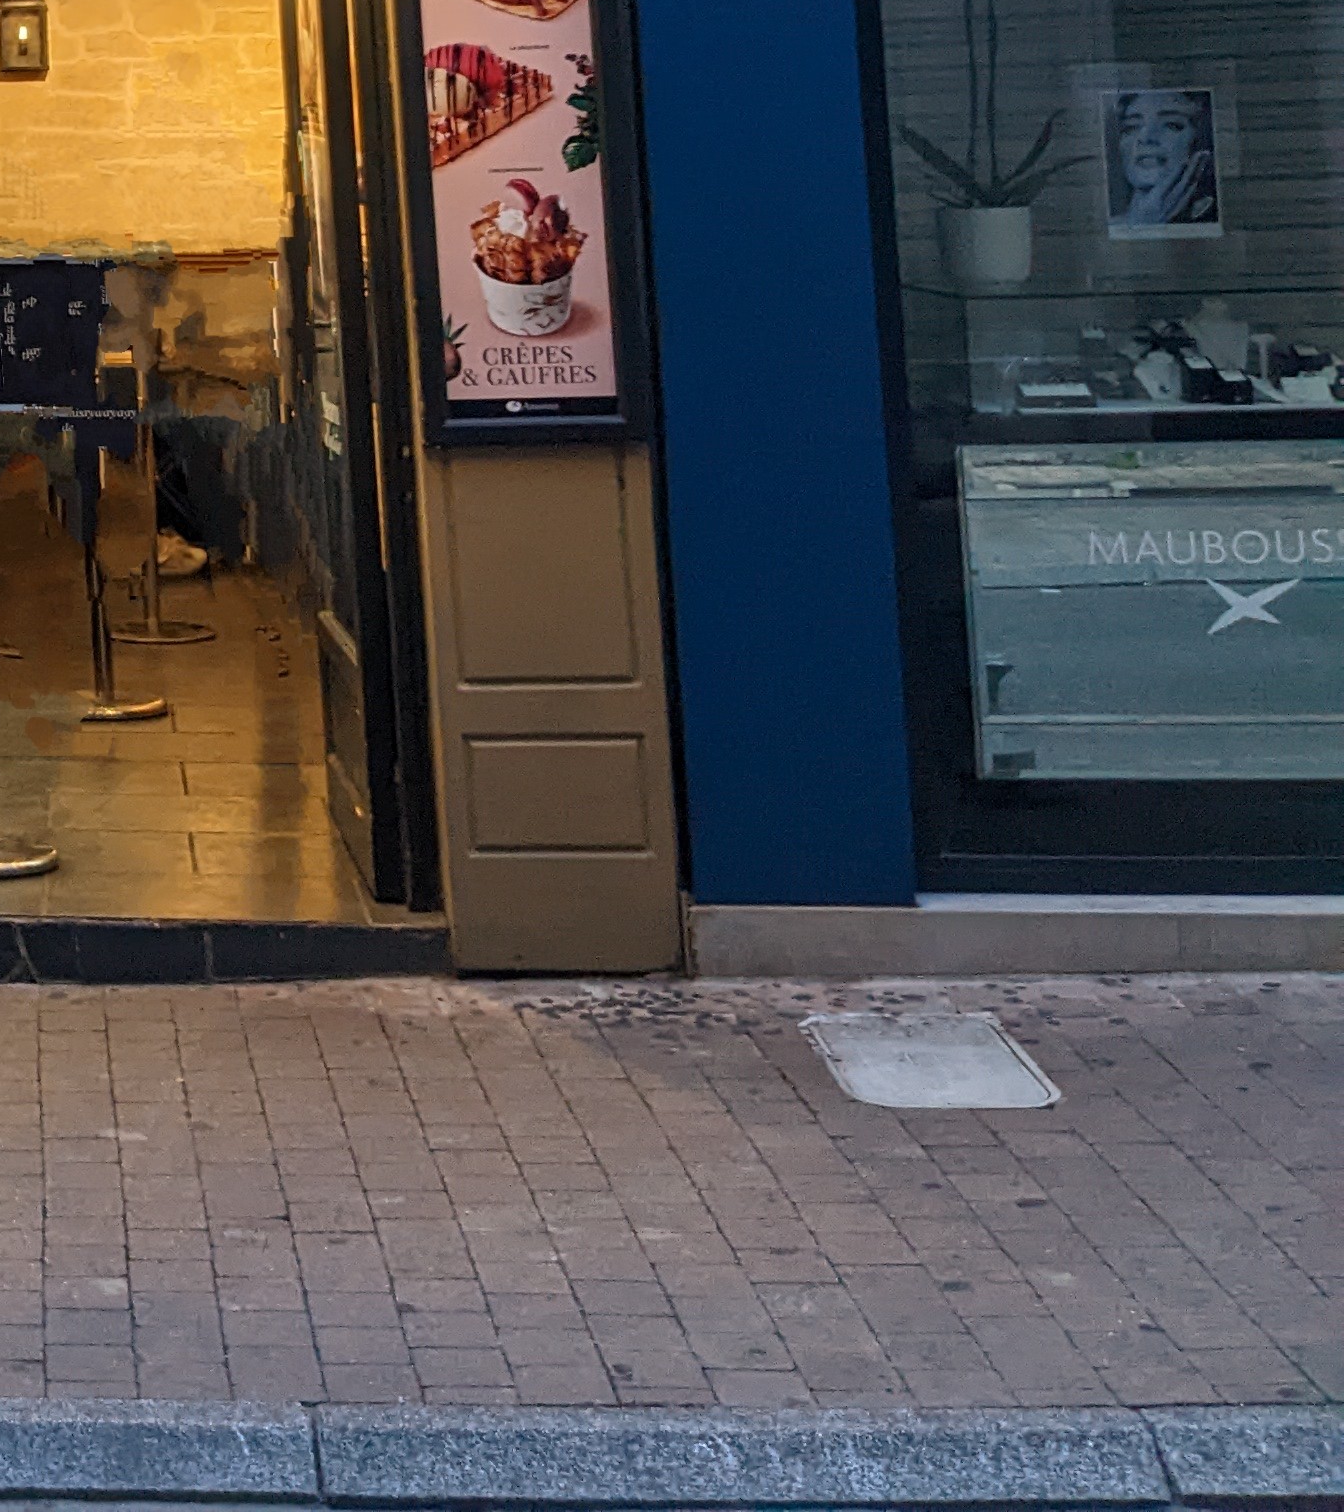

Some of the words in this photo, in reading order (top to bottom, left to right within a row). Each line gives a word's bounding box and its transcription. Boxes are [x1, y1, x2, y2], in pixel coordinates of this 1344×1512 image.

[482, 341, 574, 367] CRÊPES
[461, 367, 479, 387] &
[486, 364, 598, 387] GAUFRES
[1088, 527, 1344, 566] MAUBOUS
